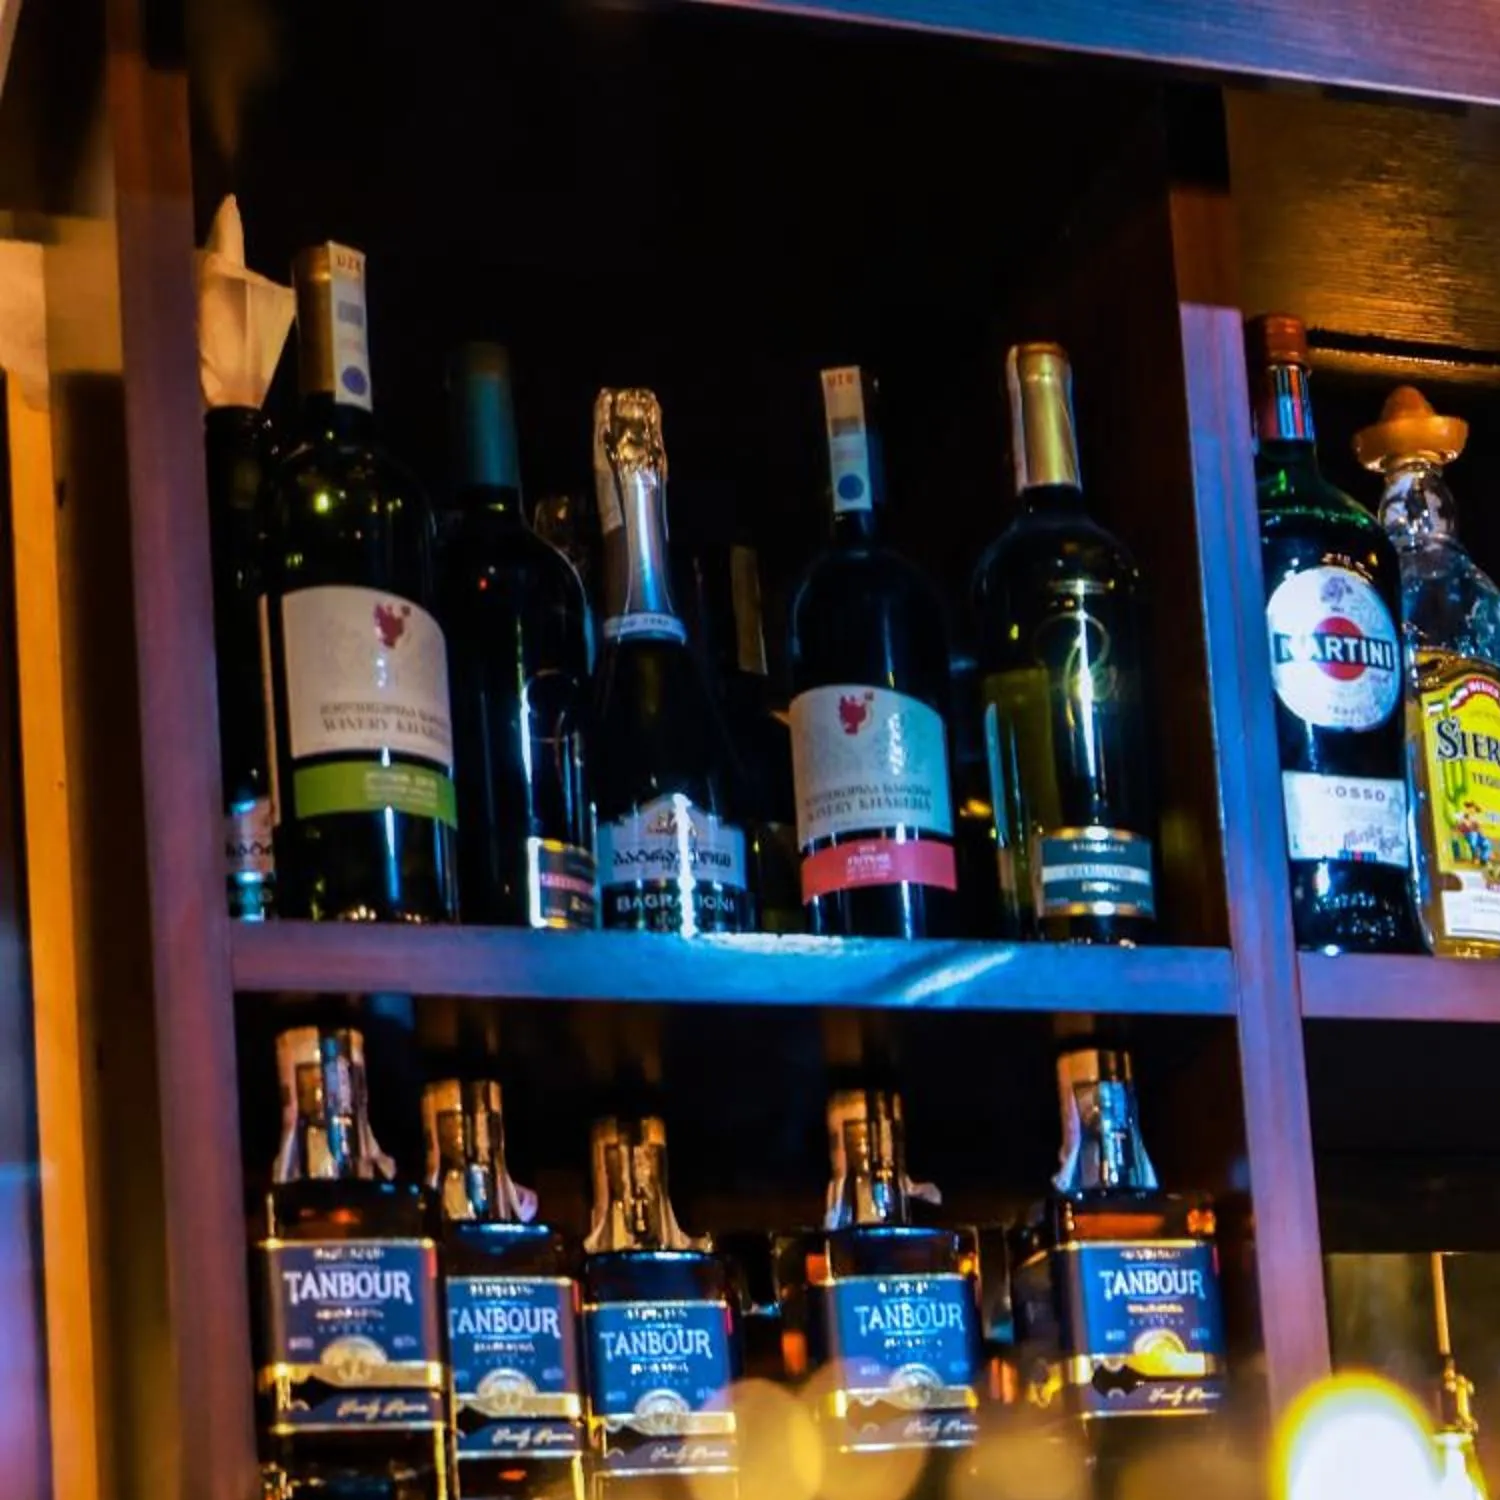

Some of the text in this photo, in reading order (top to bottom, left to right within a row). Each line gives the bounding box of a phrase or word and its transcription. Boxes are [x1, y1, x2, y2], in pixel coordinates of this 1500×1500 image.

[1279, 633, 1394, 669] ARTINI
[1327, 785, 1386, 802] OSSO
[283, 1270, 413, 1305] TANBOUR
[1098, 1269, 1206, 1301] TANBOUR
[854, 1304, 965, 1336] TANBOUR
[599, 1328, 713, 1360] TANBOUR
